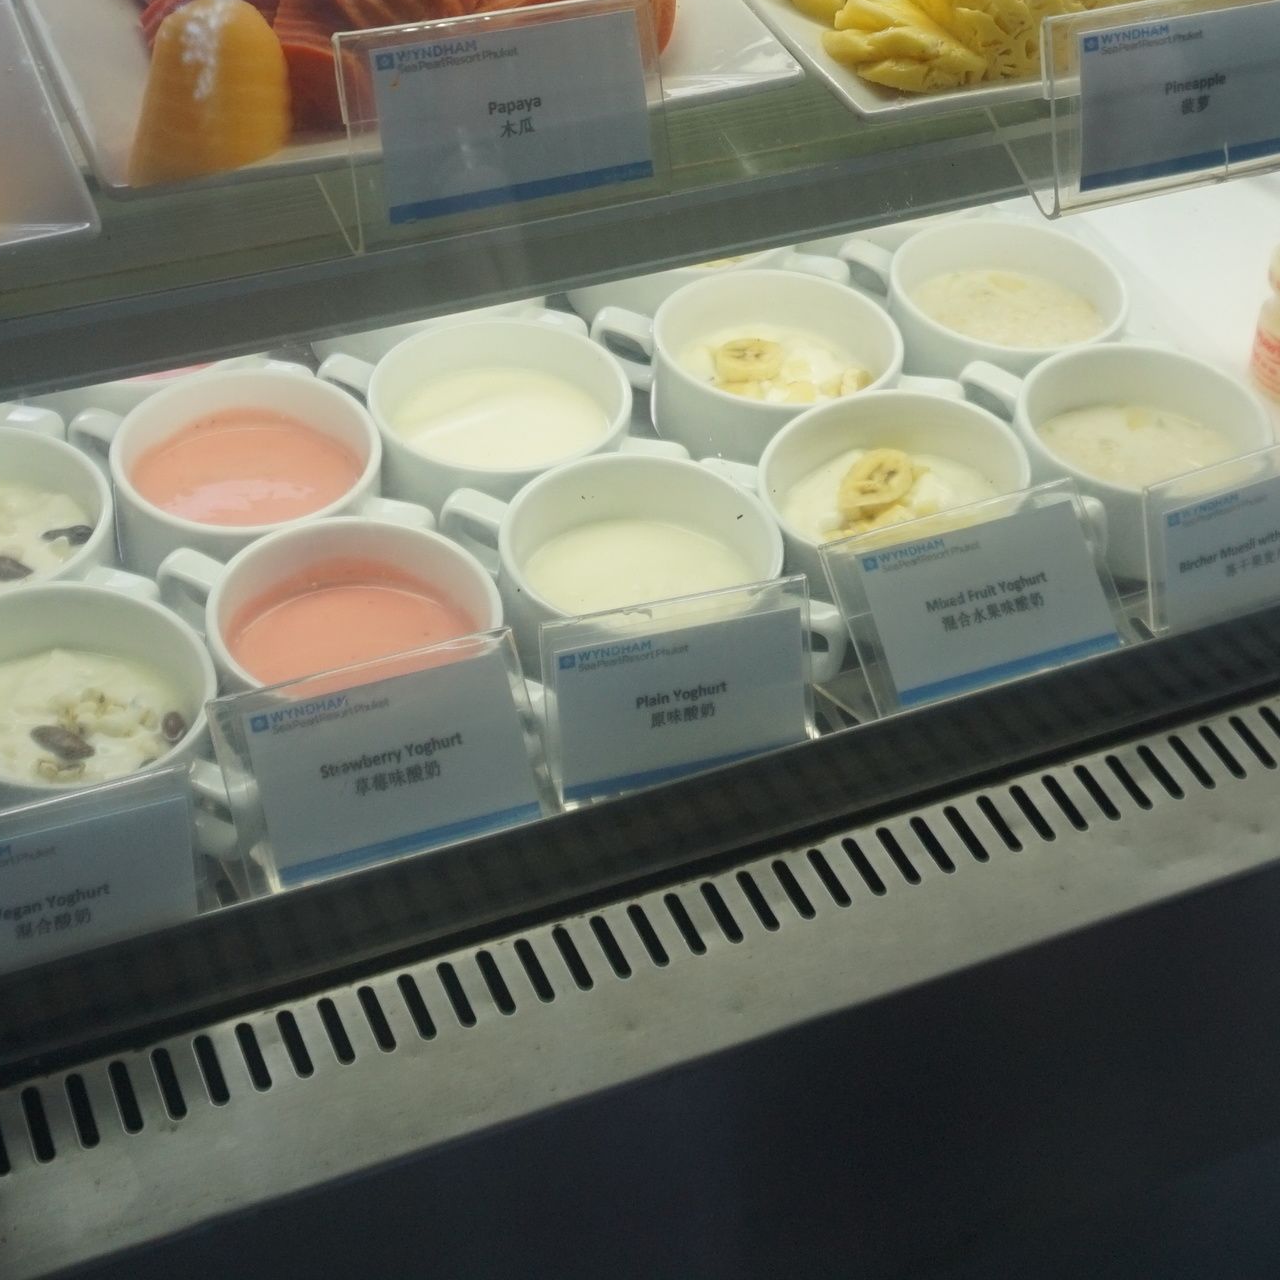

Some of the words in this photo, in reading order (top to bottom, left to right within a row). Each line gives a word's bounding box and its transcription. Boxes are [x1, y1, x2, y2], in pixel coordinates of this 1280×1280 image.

[1101, 24, 1170, 45] WYNDHAM
[397, 39, 477, 62] WYNDHAM
[1165, 73, 1227, 96] Pineapple
[488, 97, 542, 115] Papaya
[500, 116, 536, 139] 木瓜
[879, 538, 945, 563] WYNDHAM
[1179, 554, 1218, 574] Bircher
[1219, 537, 1256, 560] Muesli
[926, 592, 966, 613] Mixed
[967, 585, 997, 603] Fruit
[997, 572, 1048, 593] Yoghurt
[578, 639, 652, 663] WYNDHAM
[636, 693, 670, 709] Plain
[672, 681, 728, 702] Yoghurt
[270, 696, 349, 723] WYNDHAM
[651, 702, 716, 729] 原味酸奶
[320, 749, 402, 779] Strawberry
[404, 732, 463, 757] Yoghurt
[355, 760, 441, 797] 草莓味酸奶
[45, 884, 110, 909] Yoghurt
